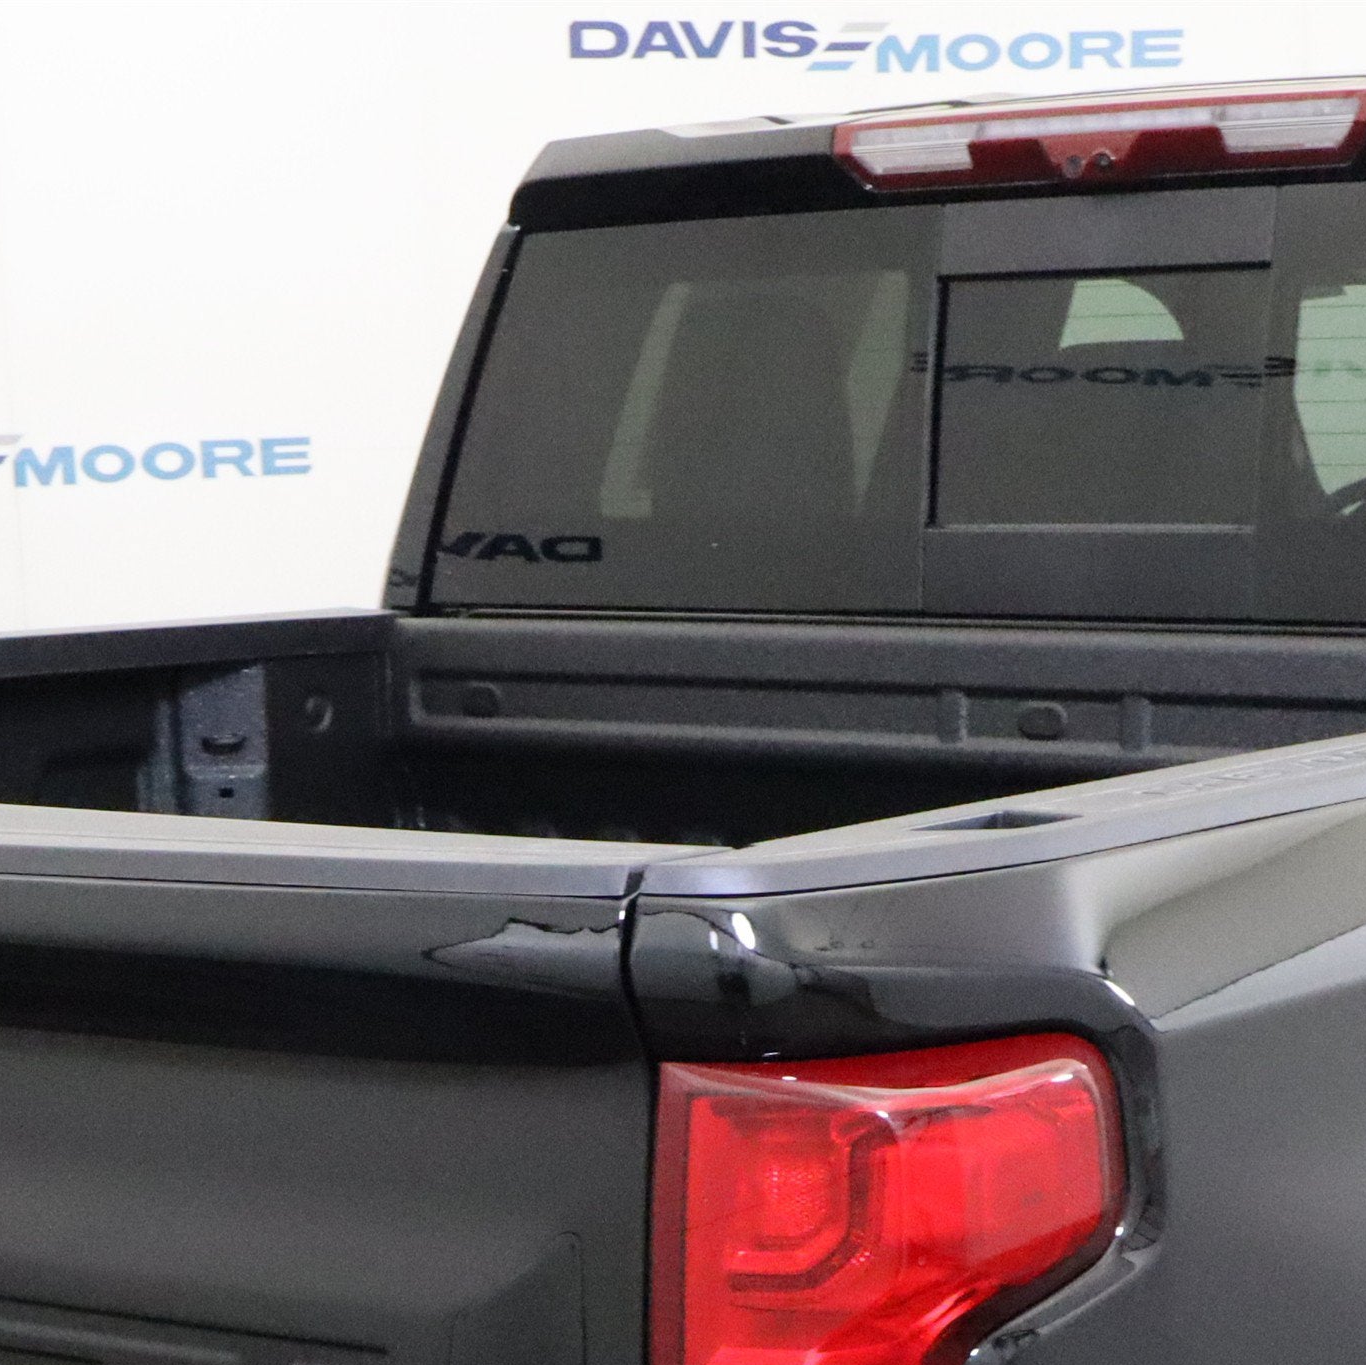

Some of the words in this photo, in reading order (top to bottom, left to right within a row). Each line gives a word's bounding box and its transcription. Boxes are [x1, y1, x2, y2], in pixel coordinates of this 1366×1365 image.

[568, 19, 819, 60] DAVIS
[876, 28, 1185, 73] MOORE
[13, 435, 313, 488] MOORE
